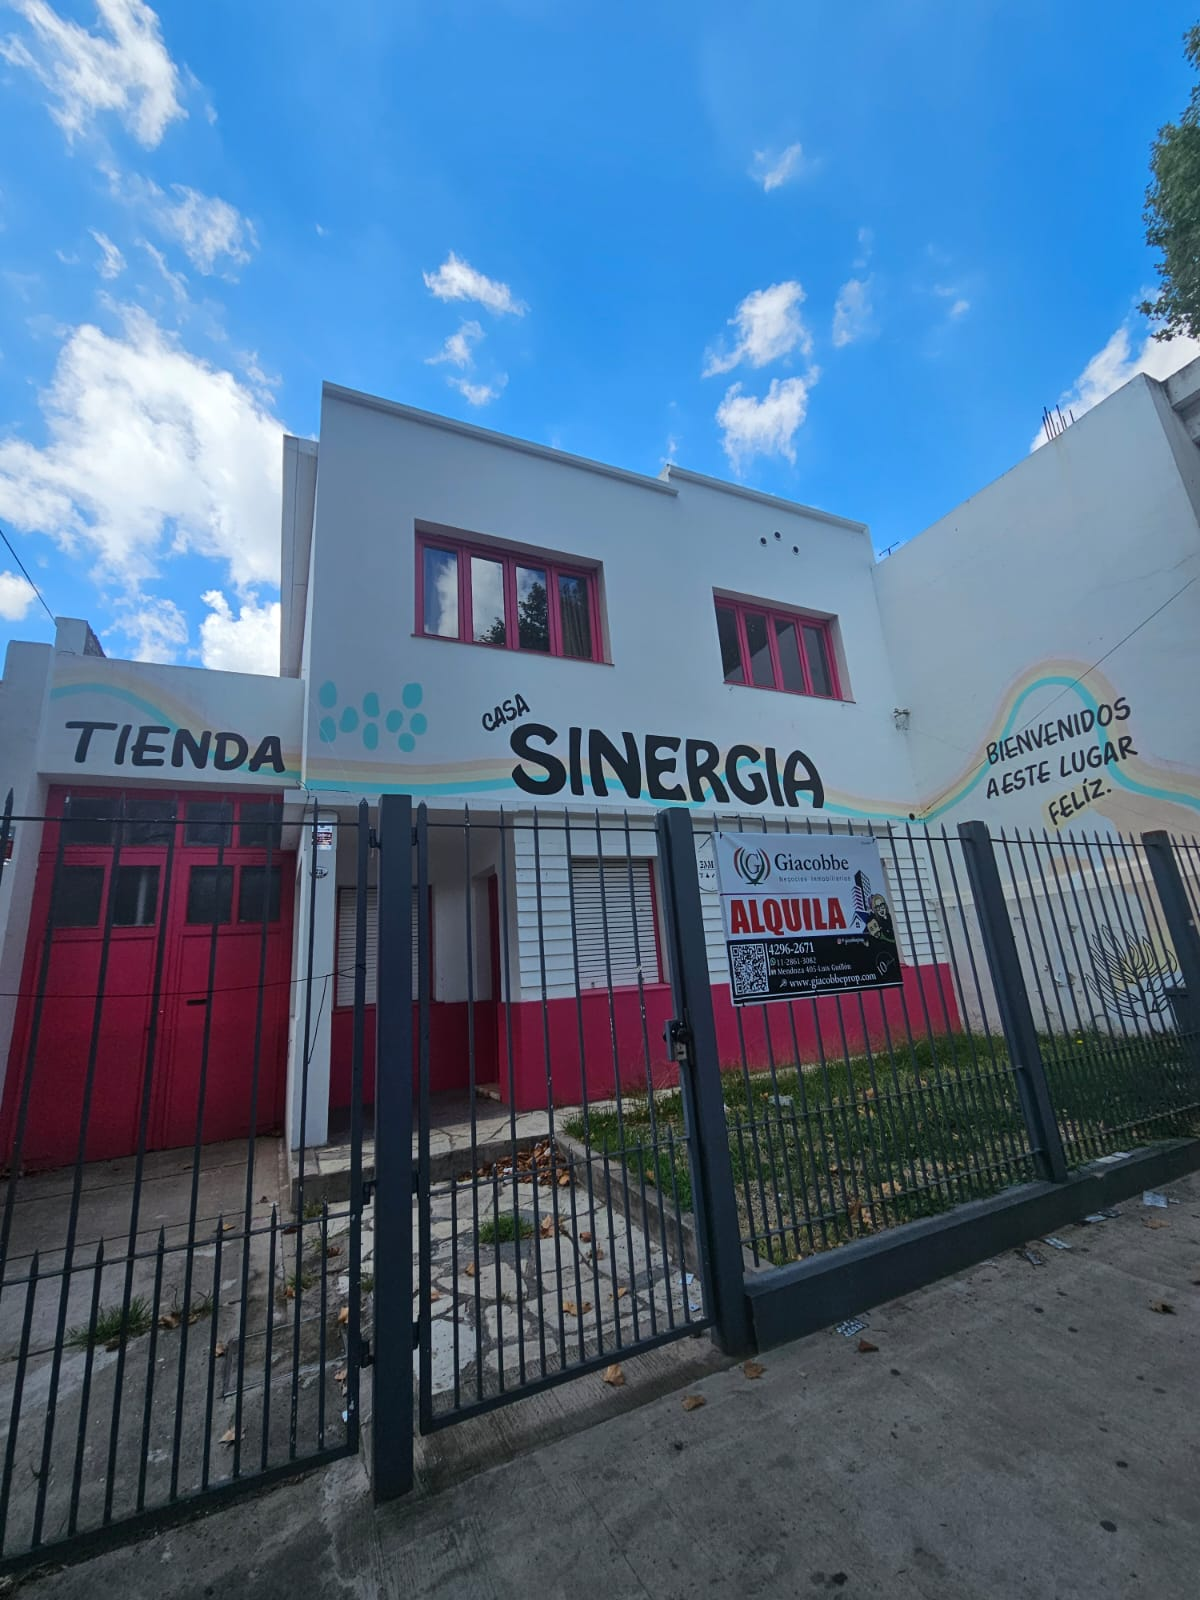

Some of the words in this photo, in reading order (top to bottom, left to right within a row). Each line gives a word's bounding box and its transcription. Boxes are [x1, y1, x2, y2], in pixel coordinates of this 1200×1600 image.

[482, 693, 531, 731] CASA
[986, 697, 1131, 765] BIENVENIDOS
[65, 721, 286, 773] TIENDA
[510, 722, 825, 808] SINERGIA
[1060, 735, 1139, 778] LUGAR
[774, 853, 849, 871] Giacobbe
[730, 897, 848, 936] ALQUILA
[768, 942, 815, 956] 4296-2671
[789, 973, 877, 989] www.giacobbeprop.com
